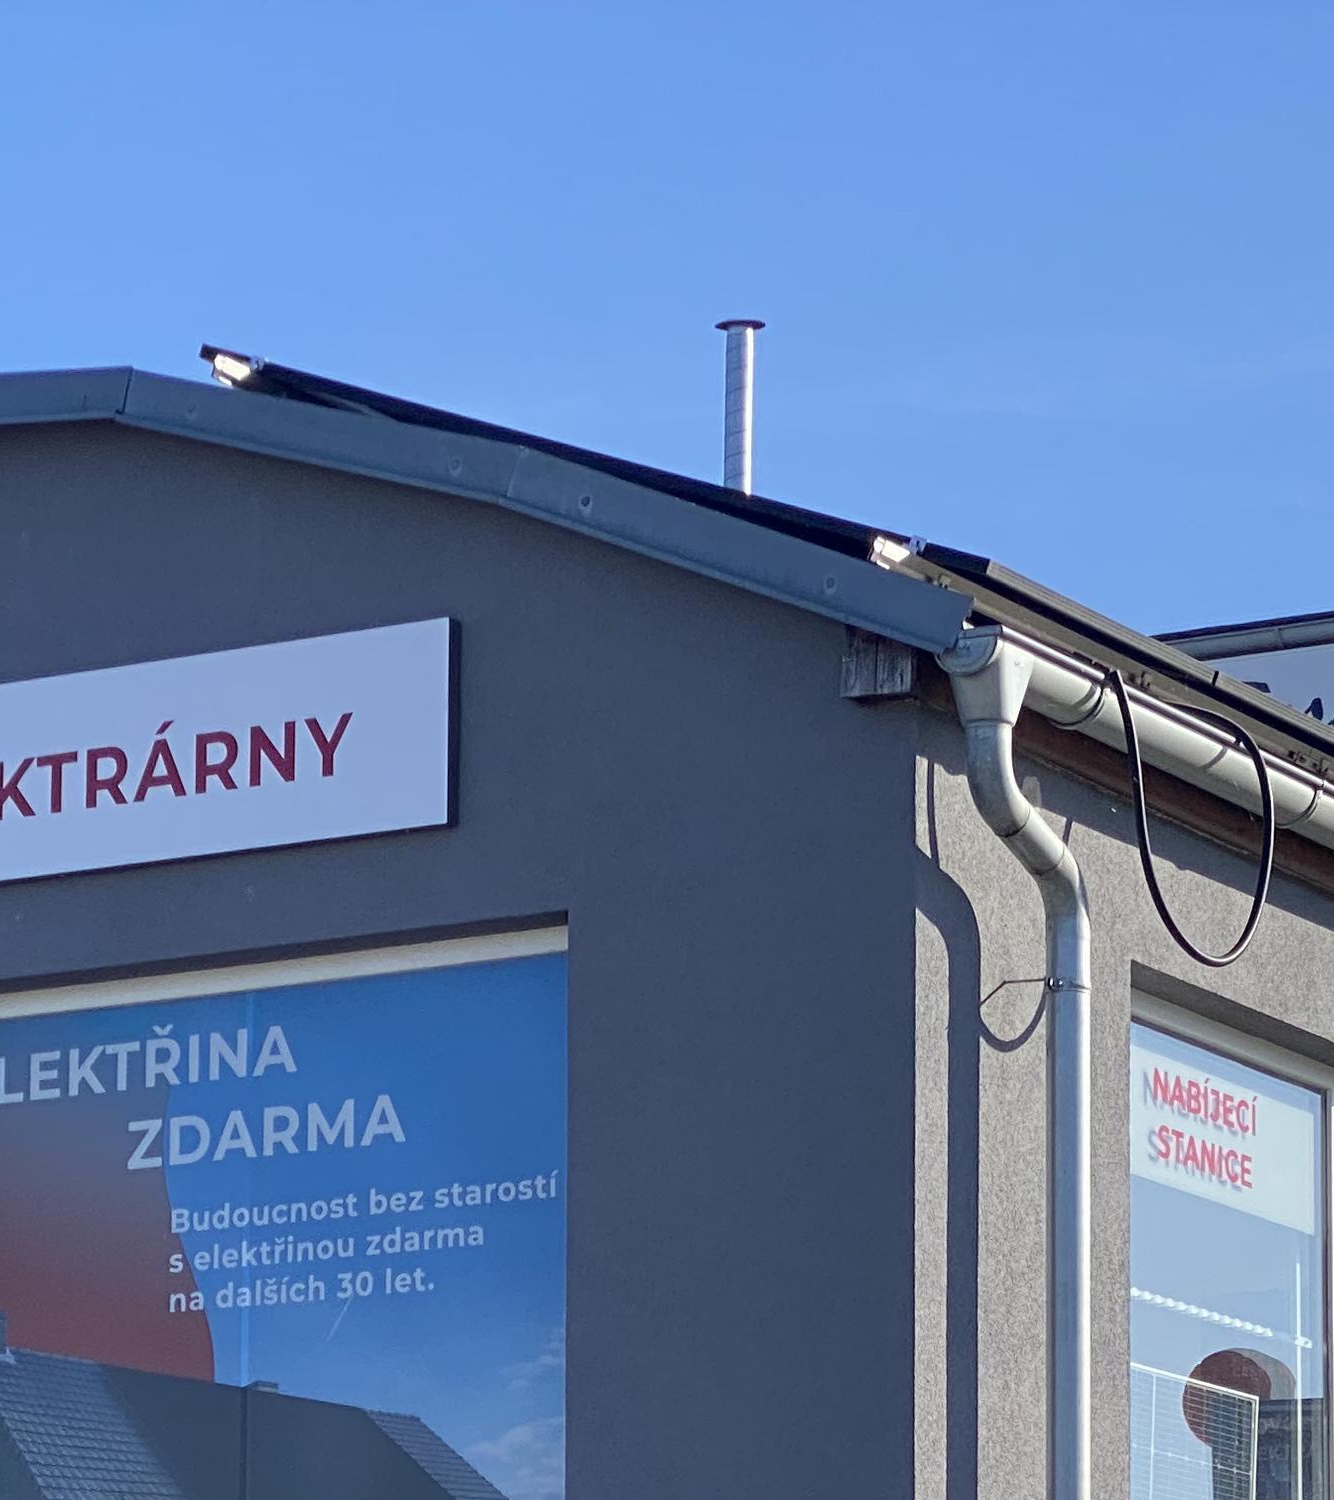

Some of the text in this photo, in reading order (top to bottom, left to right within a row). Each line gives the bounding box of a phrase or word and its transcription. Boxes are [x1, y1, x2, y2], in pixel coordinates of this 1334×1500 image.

[126, 1094, 406, 1170] ZDARMA
[1153, 1067, 1258, 1137] NABÍJECÍ
[1156, 1124, 1253, 1189] STANICE
[170, 1170, 558, 1235] Budoucnost bez starostí
[169, 1223, 485, 1275] s elektřinou zdarma
[169, 1267, 435, 1313] na dalších 30 let.
